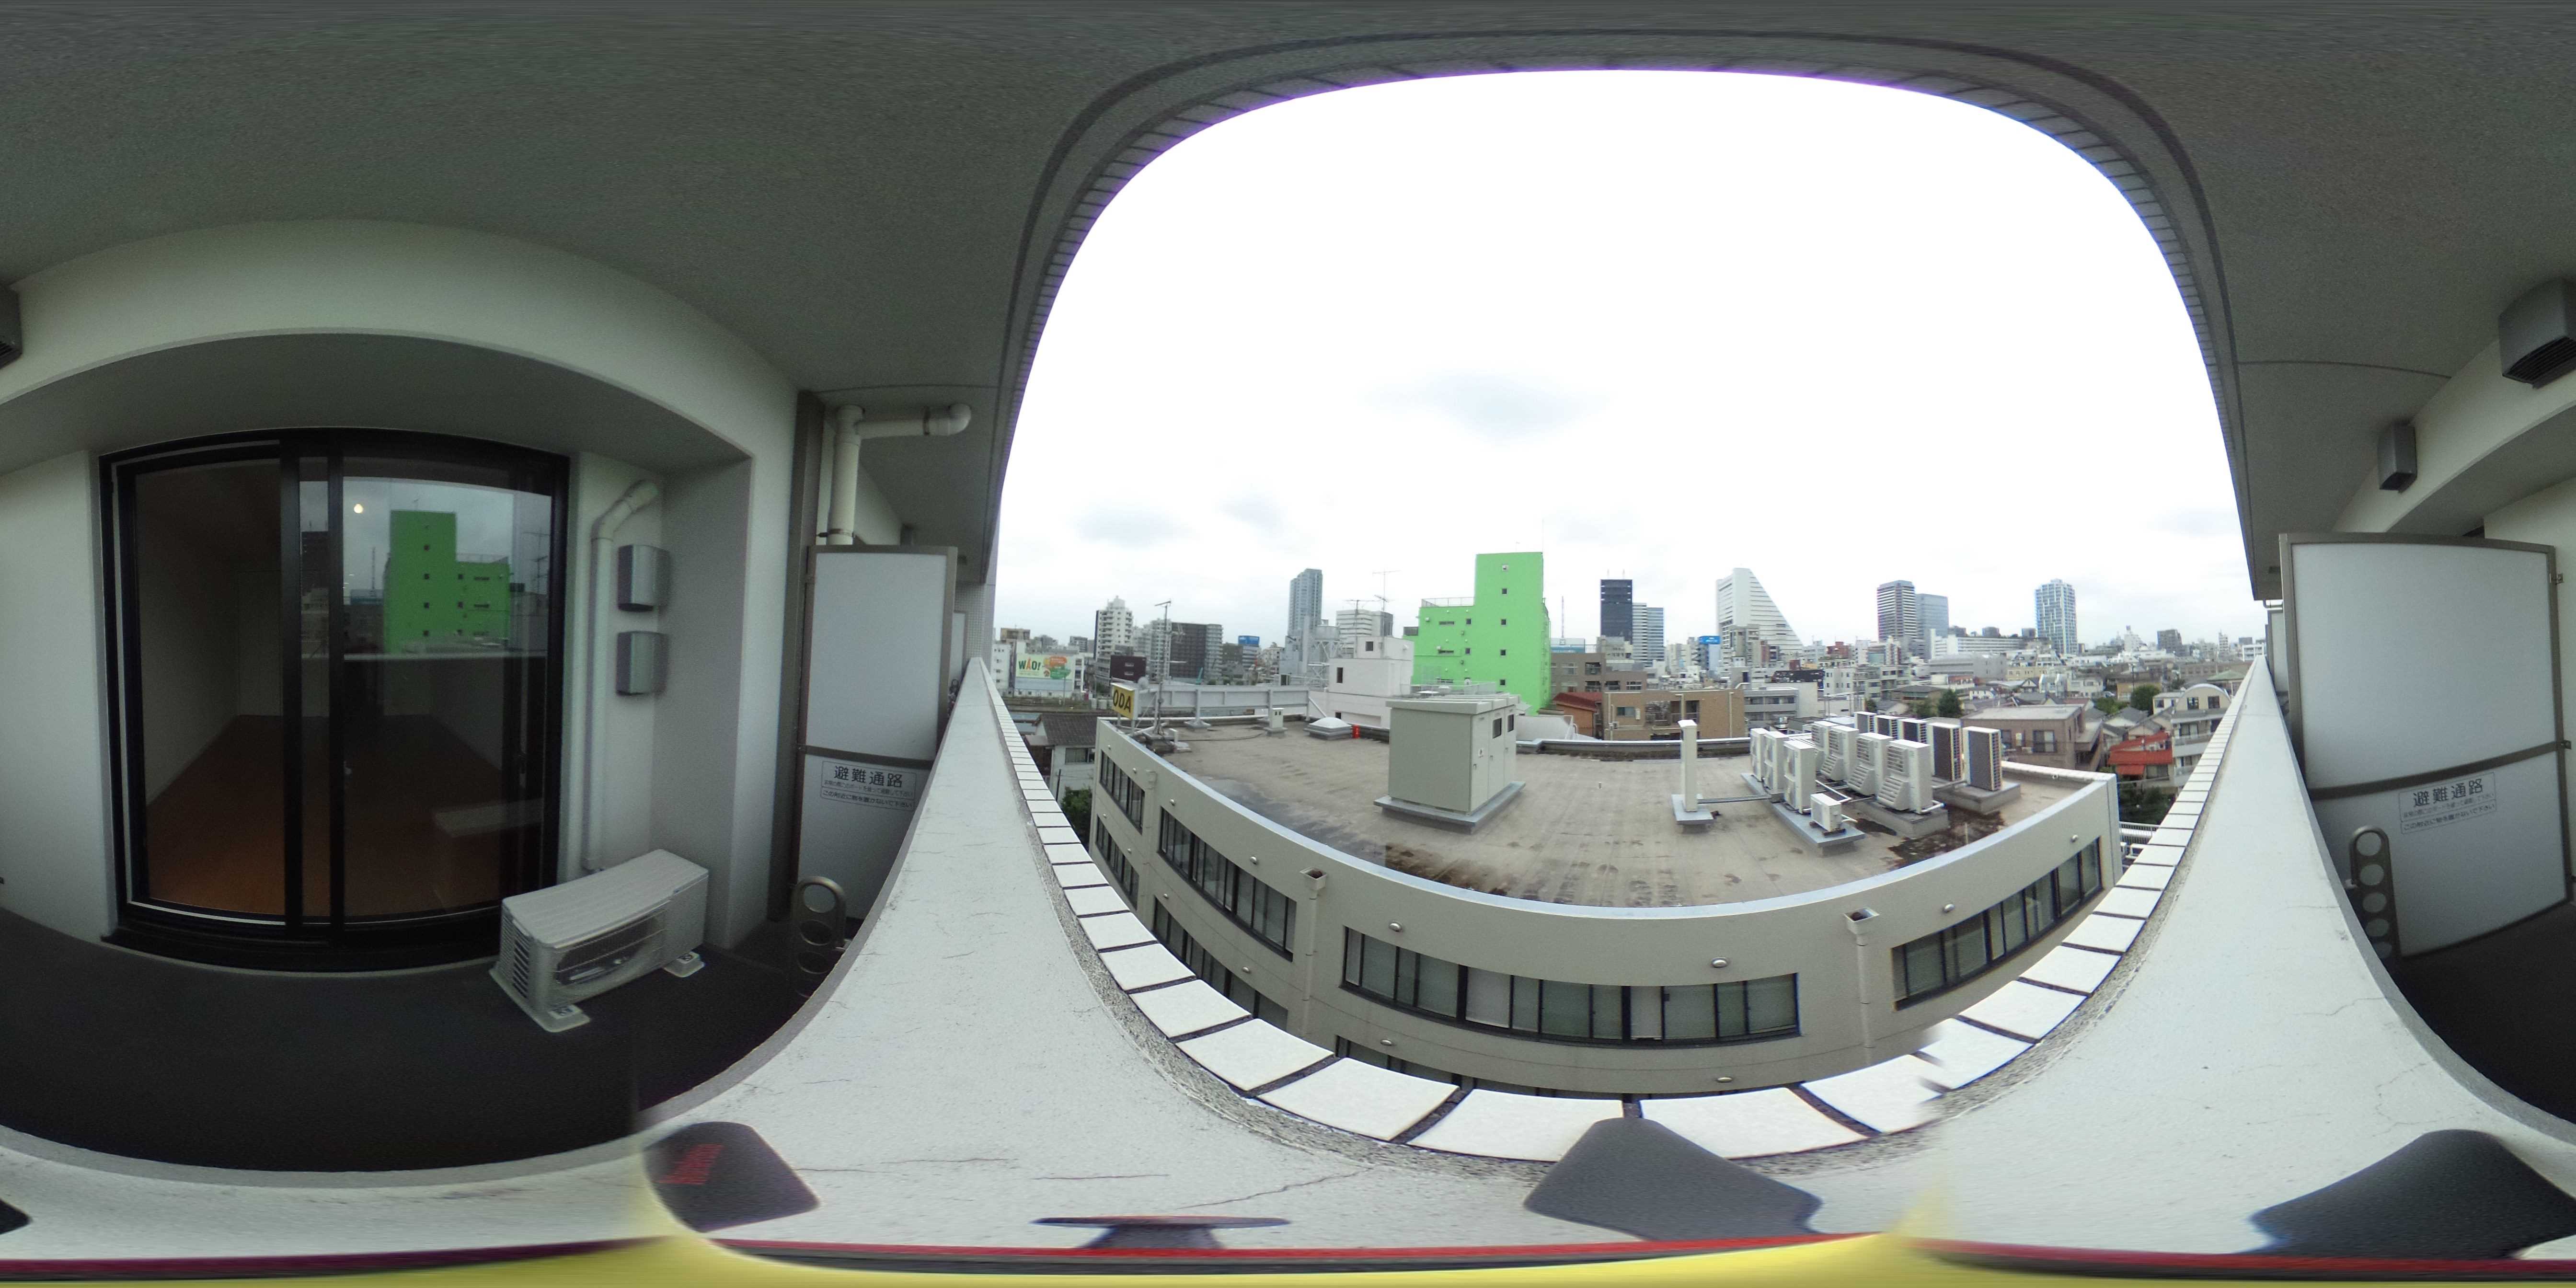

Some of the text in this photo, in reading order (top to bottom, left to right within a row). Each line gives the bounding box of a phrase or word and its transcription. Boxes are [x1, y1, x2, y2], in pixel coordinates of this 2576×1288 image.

[1113, 689, 1131, 713] ODA
[834, 765, 903, 788] 避難通路
[2413, 778, 2483, 807] 避難通路
